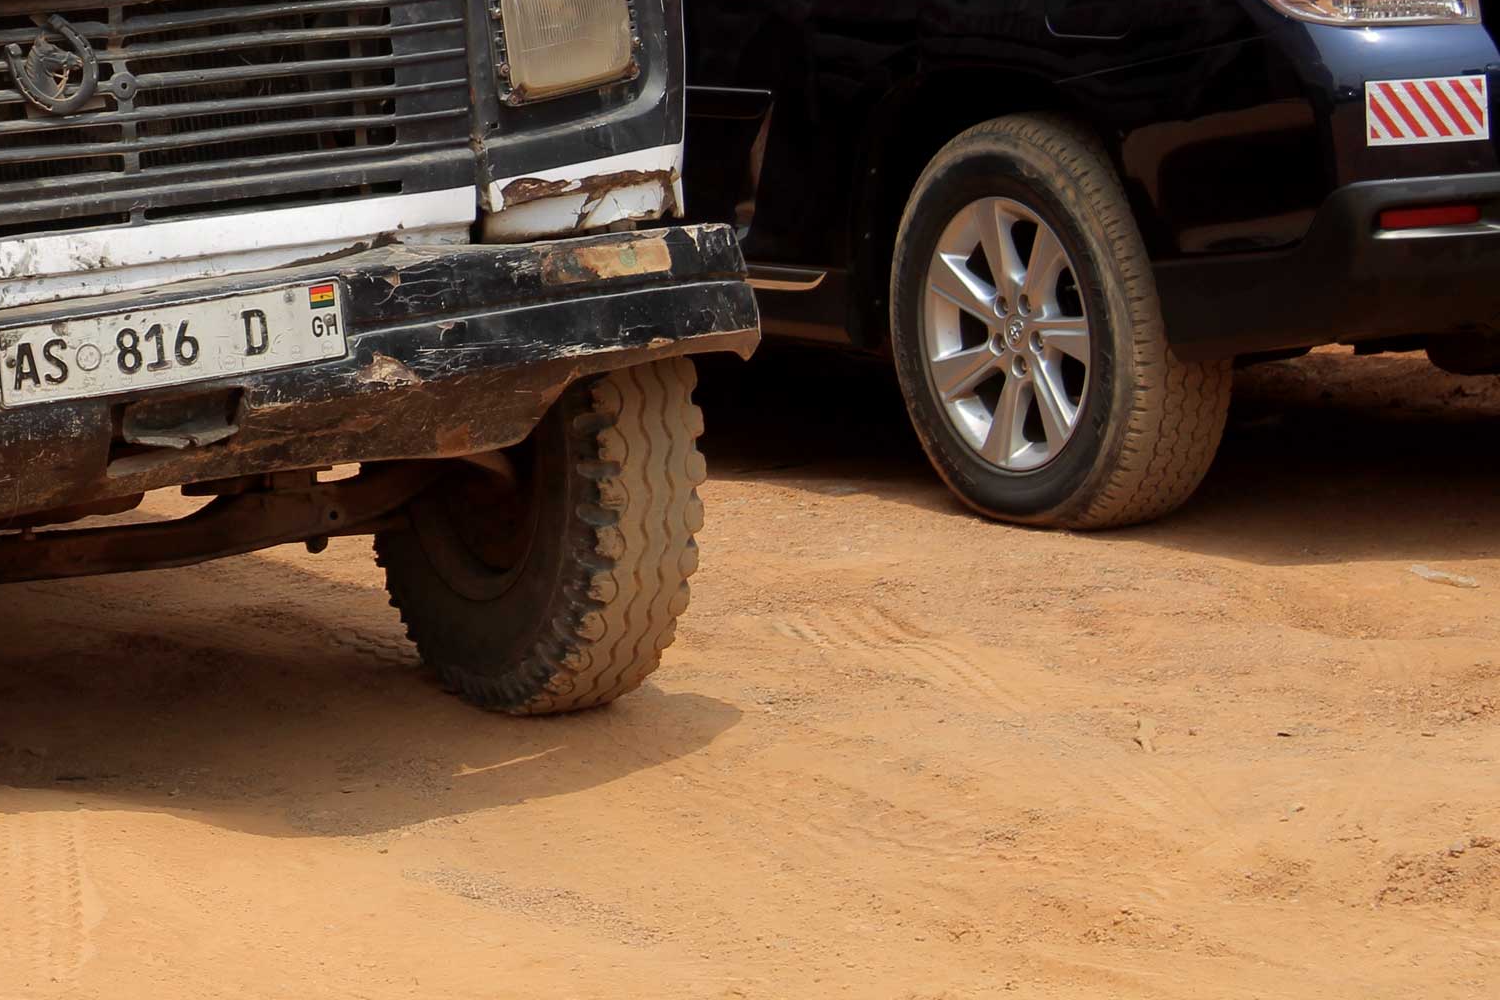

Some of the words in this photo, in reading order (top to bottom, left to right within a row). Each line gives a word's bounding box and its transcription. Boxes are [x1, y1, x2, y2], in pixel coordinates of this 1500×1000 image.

[13, 338, 69, 391] AS
[116, 319, 200, 375] 816
[240, 308, 269, 357] D
[311, 312, 338, 338] GH
